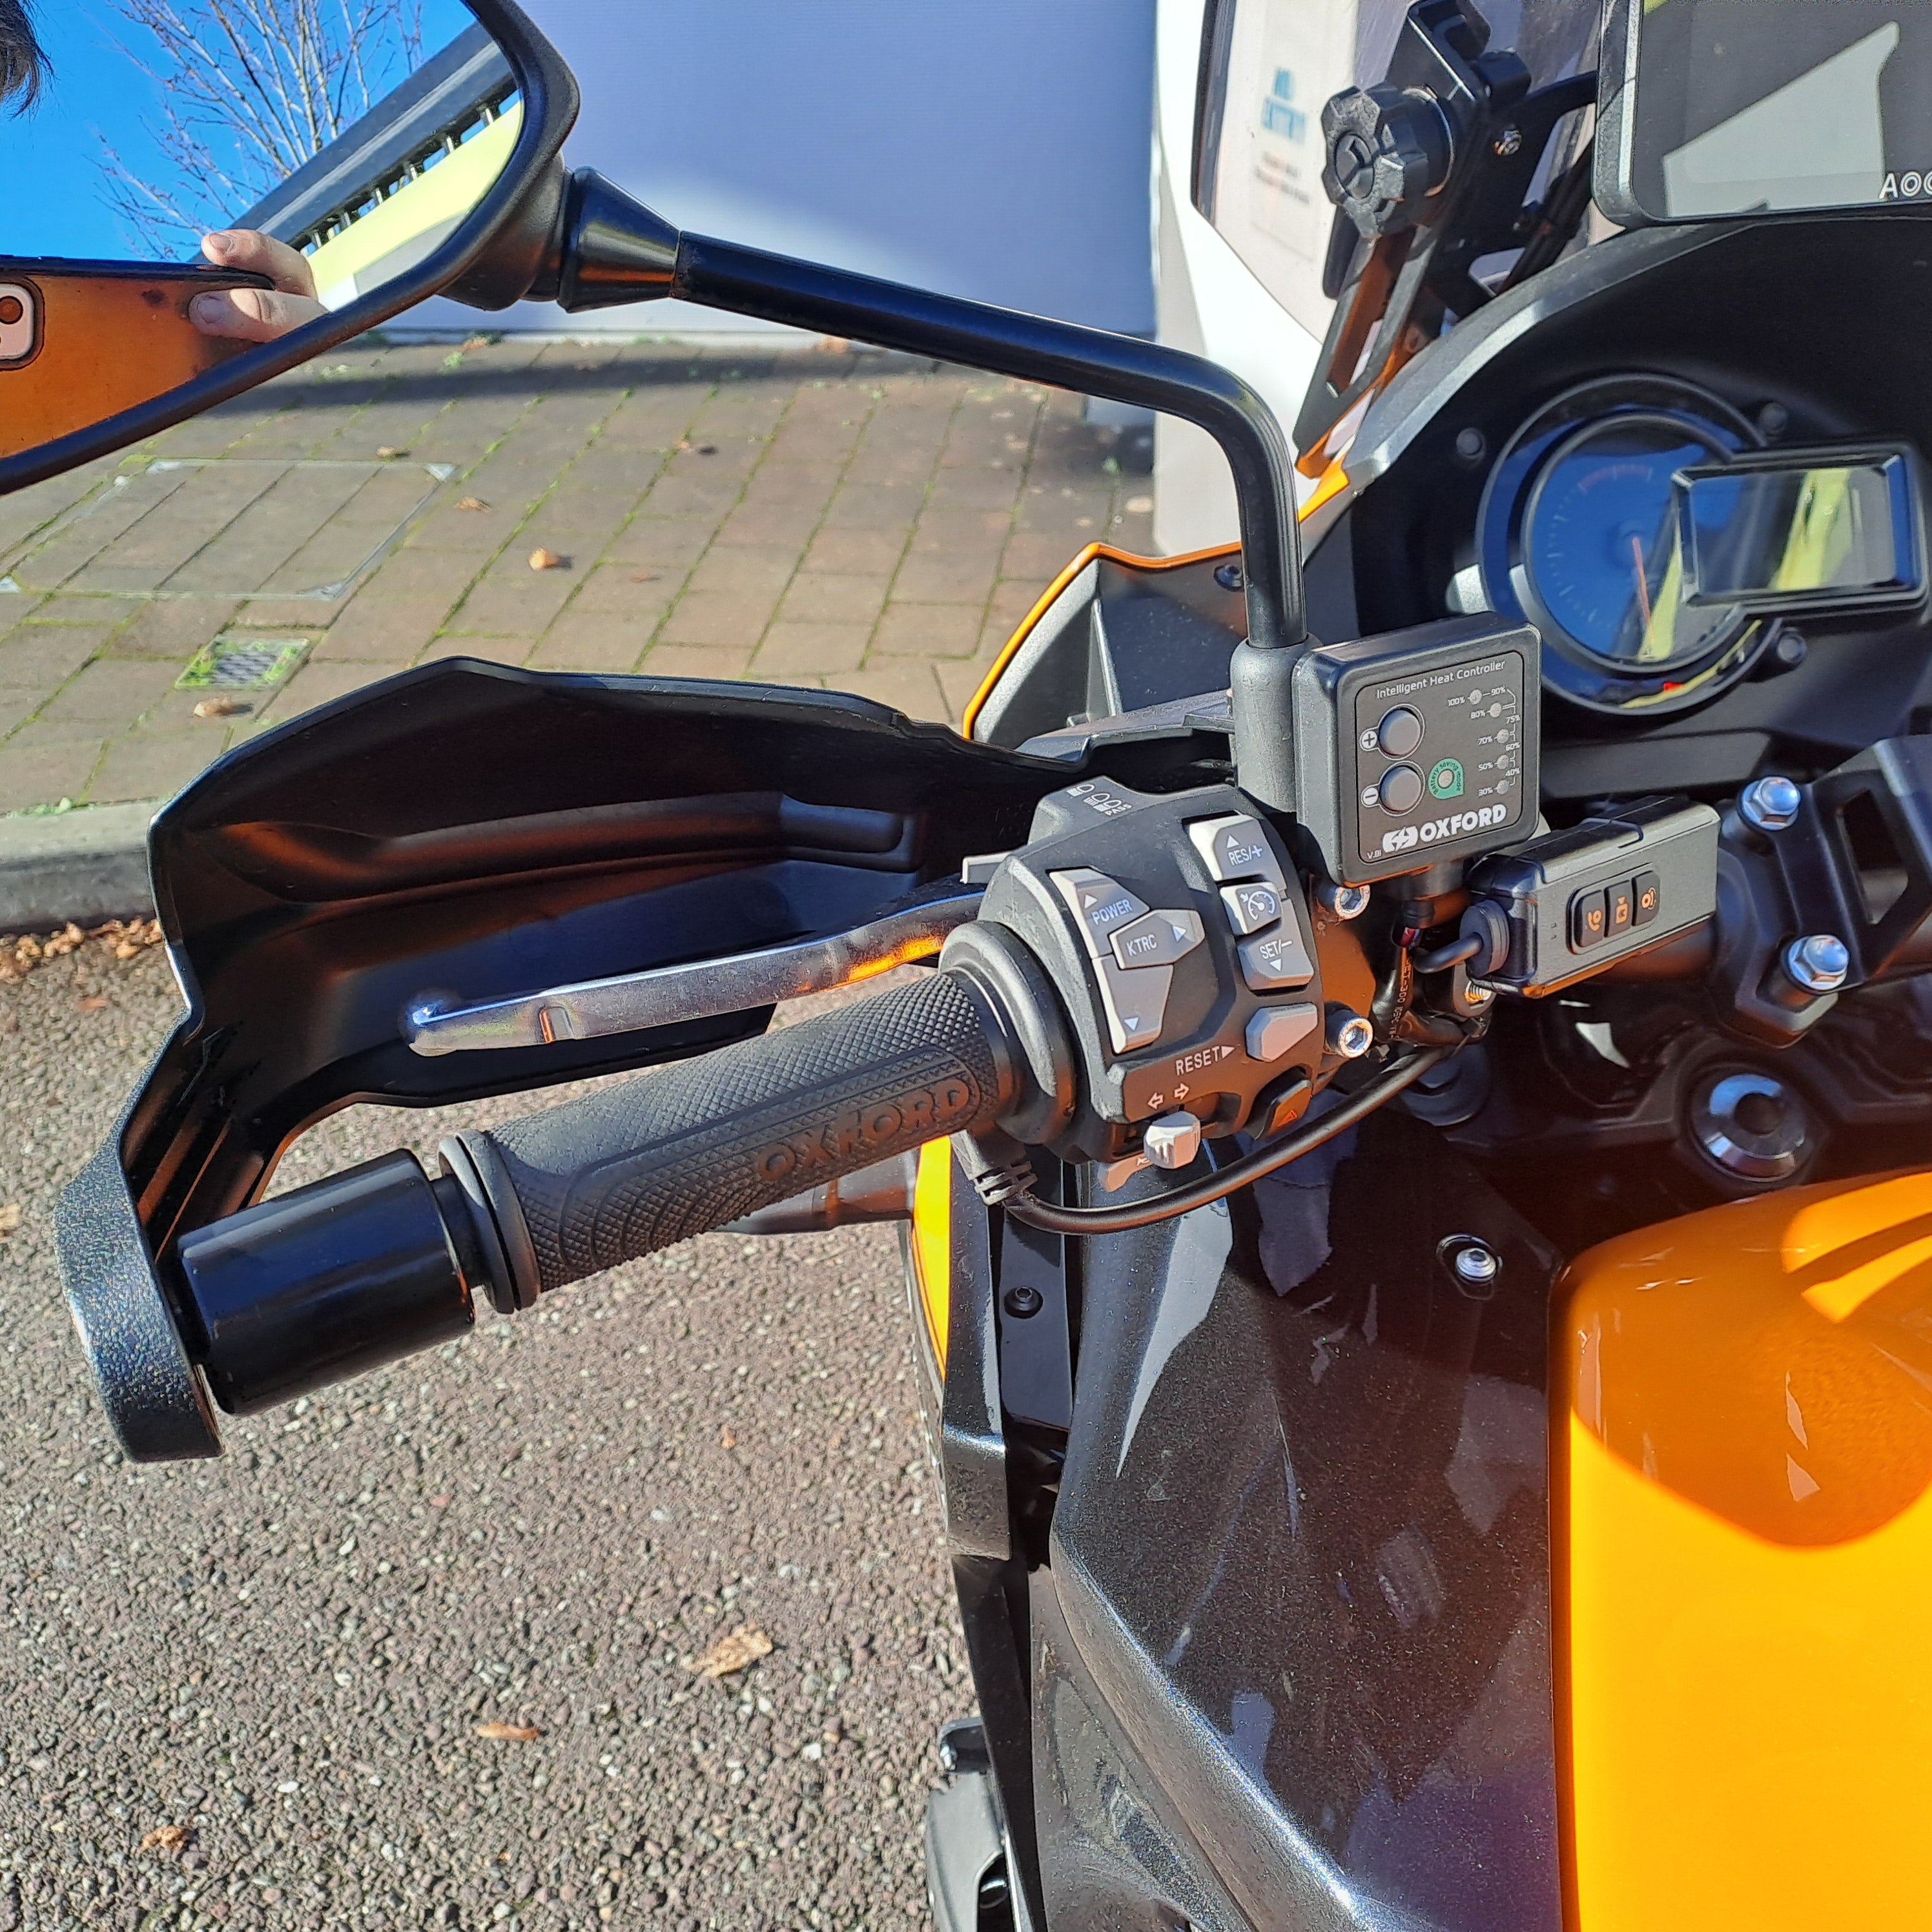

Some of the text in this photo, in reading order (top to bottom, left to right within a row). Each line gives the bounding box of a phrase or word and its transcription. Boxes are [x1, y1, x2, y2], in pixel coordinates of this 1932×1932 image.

[1376, 661, 1505, 699] Intelligent Heat Controller
[1491, 686, 1506, 696] 90%
[1447, 697, 1466, 706] 100%
[1471, 710, 1486, 719] 80%
[1506, 714, 1521, 724] 75%
[1477, 735, 1493, 745] 70%
[1505, 742, 1520, 751] 60%
[1478, 762, 1494, 772] 50%
[1505, 768, 1520, 776] 40%
[1430, 768, 1439, 795] Battery
[1439, 761, 1459, 772] saving
[1478, 787, 1494, 797] 30%
[1104, 804, 1132, 816] PASS
[1420, 804, 1506, 842] OXFORD
[1228, 845, 1262, 865] RES/+
[1091, 899, 1133, 925] POWER
[1126, 934, 1157, 956] KTRC
[1176, 1045, 1220, 1076] RESET
[757, 1078, 969, 1180] OXFORD
